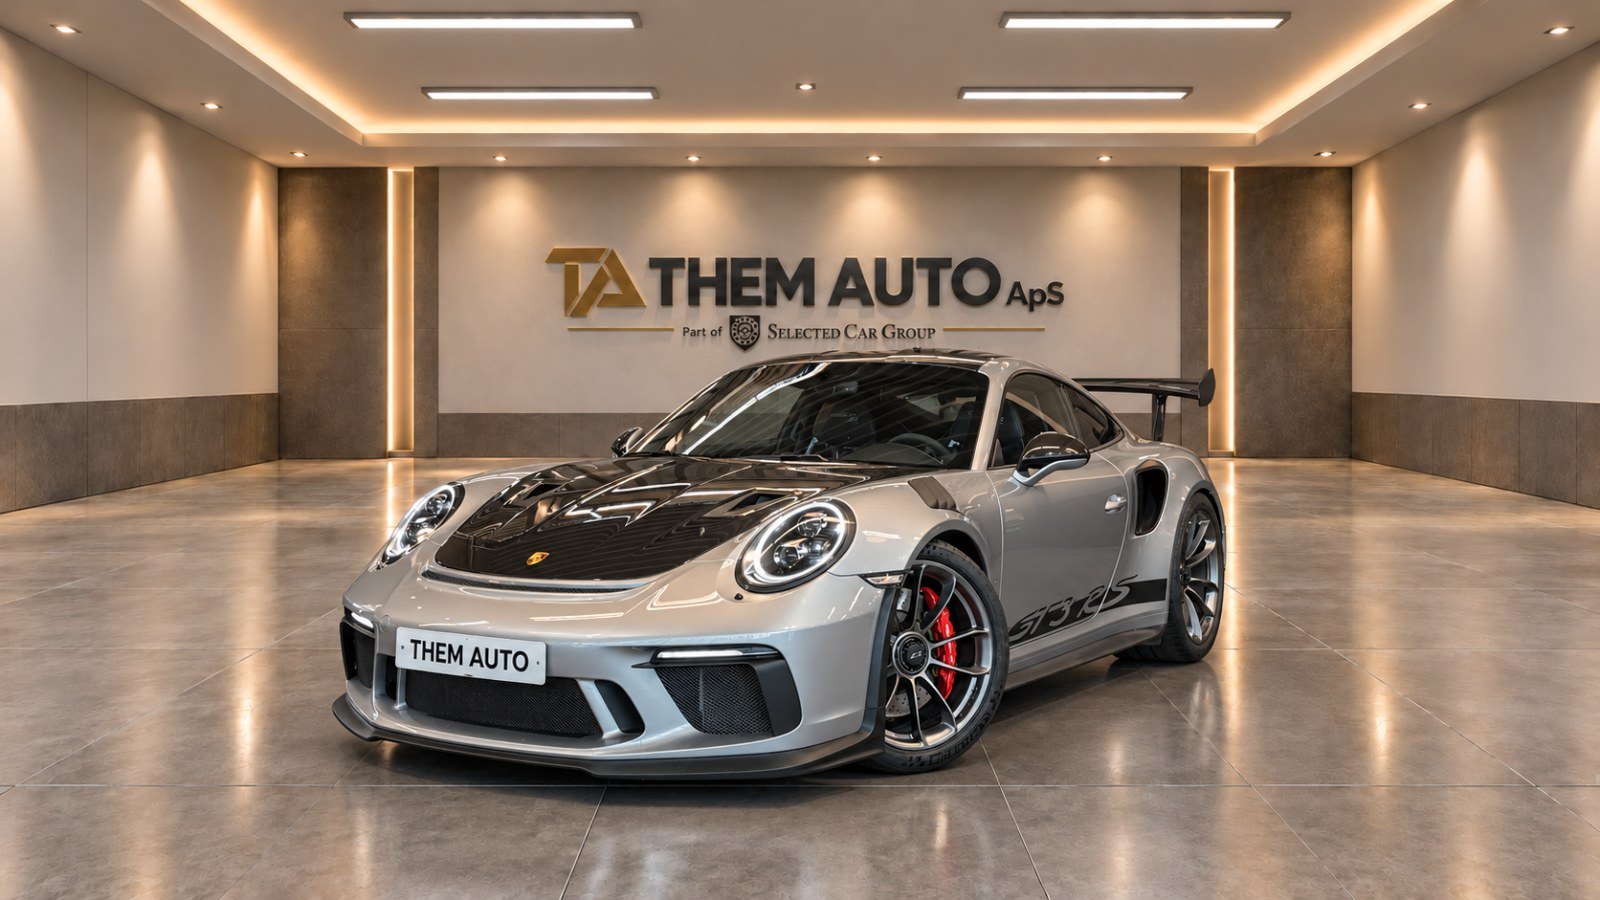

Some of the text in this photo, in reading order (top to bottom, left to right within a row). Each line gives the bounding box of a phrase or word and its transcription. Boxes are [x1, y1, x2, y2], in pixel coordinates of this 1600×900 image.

[648, 257, 1065, 312] THEM AUTO ApS
[682, 323, 936, 340] Part of SELECTED CAR GROUP
[1008, 597, 1073, 642] GT3
[410, 639, 529, 672] THEM AUTO
